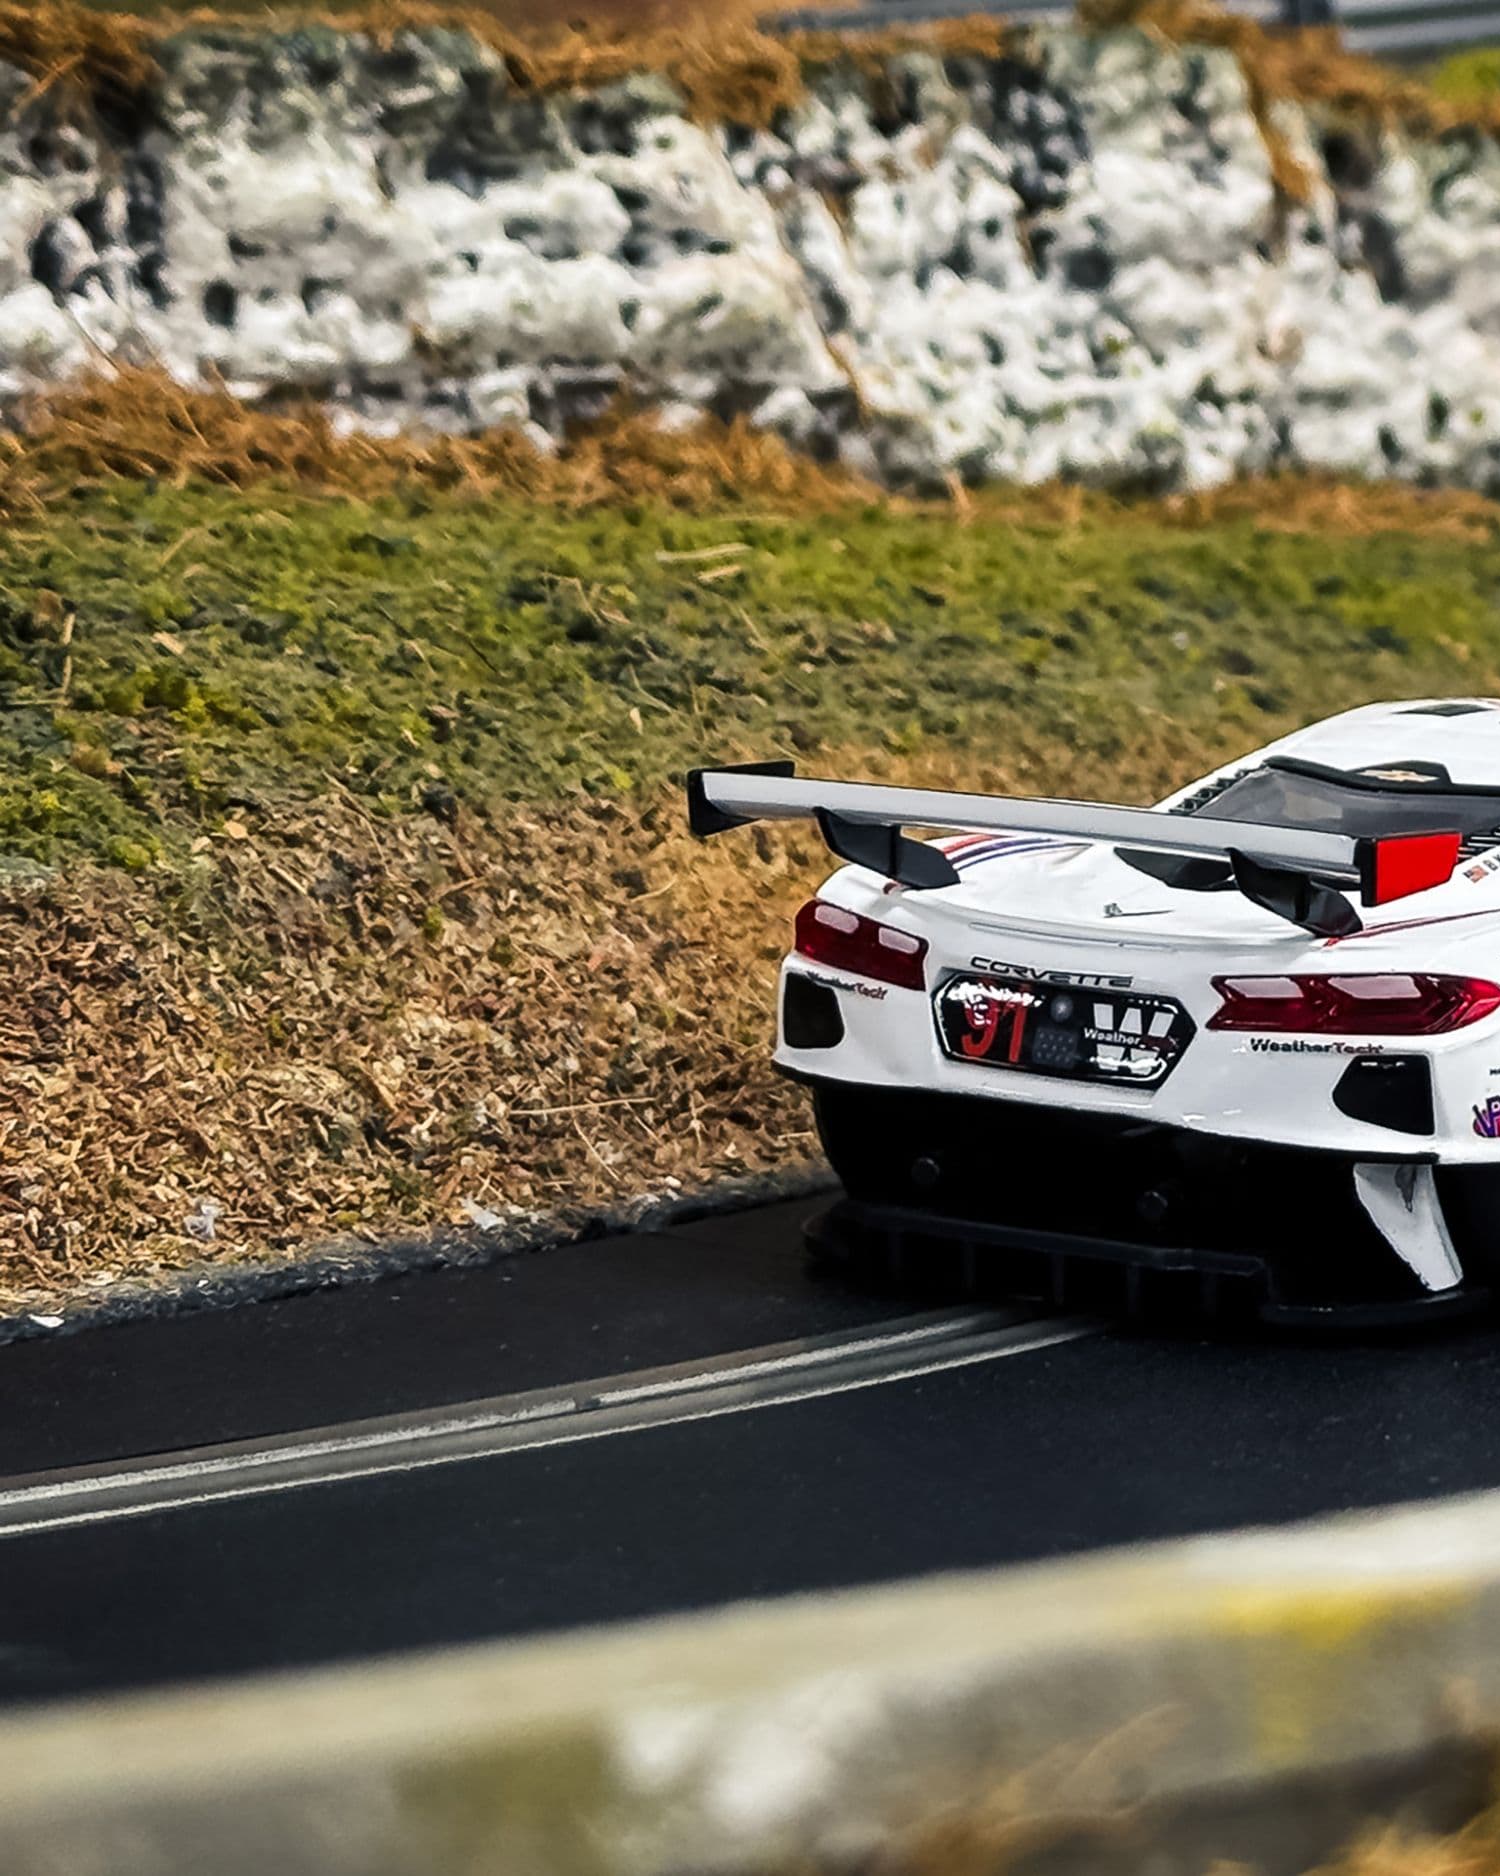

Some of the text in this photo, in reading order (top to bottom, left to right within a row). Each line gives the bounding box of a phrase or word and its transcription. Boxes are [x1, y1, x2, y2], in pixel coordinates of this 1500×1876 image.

[970, 956, 1134, 988] CORVETTE
[961, 975, 1034, 1064] 91
[1250, 1037, 1384, 1054] WeatherTech
